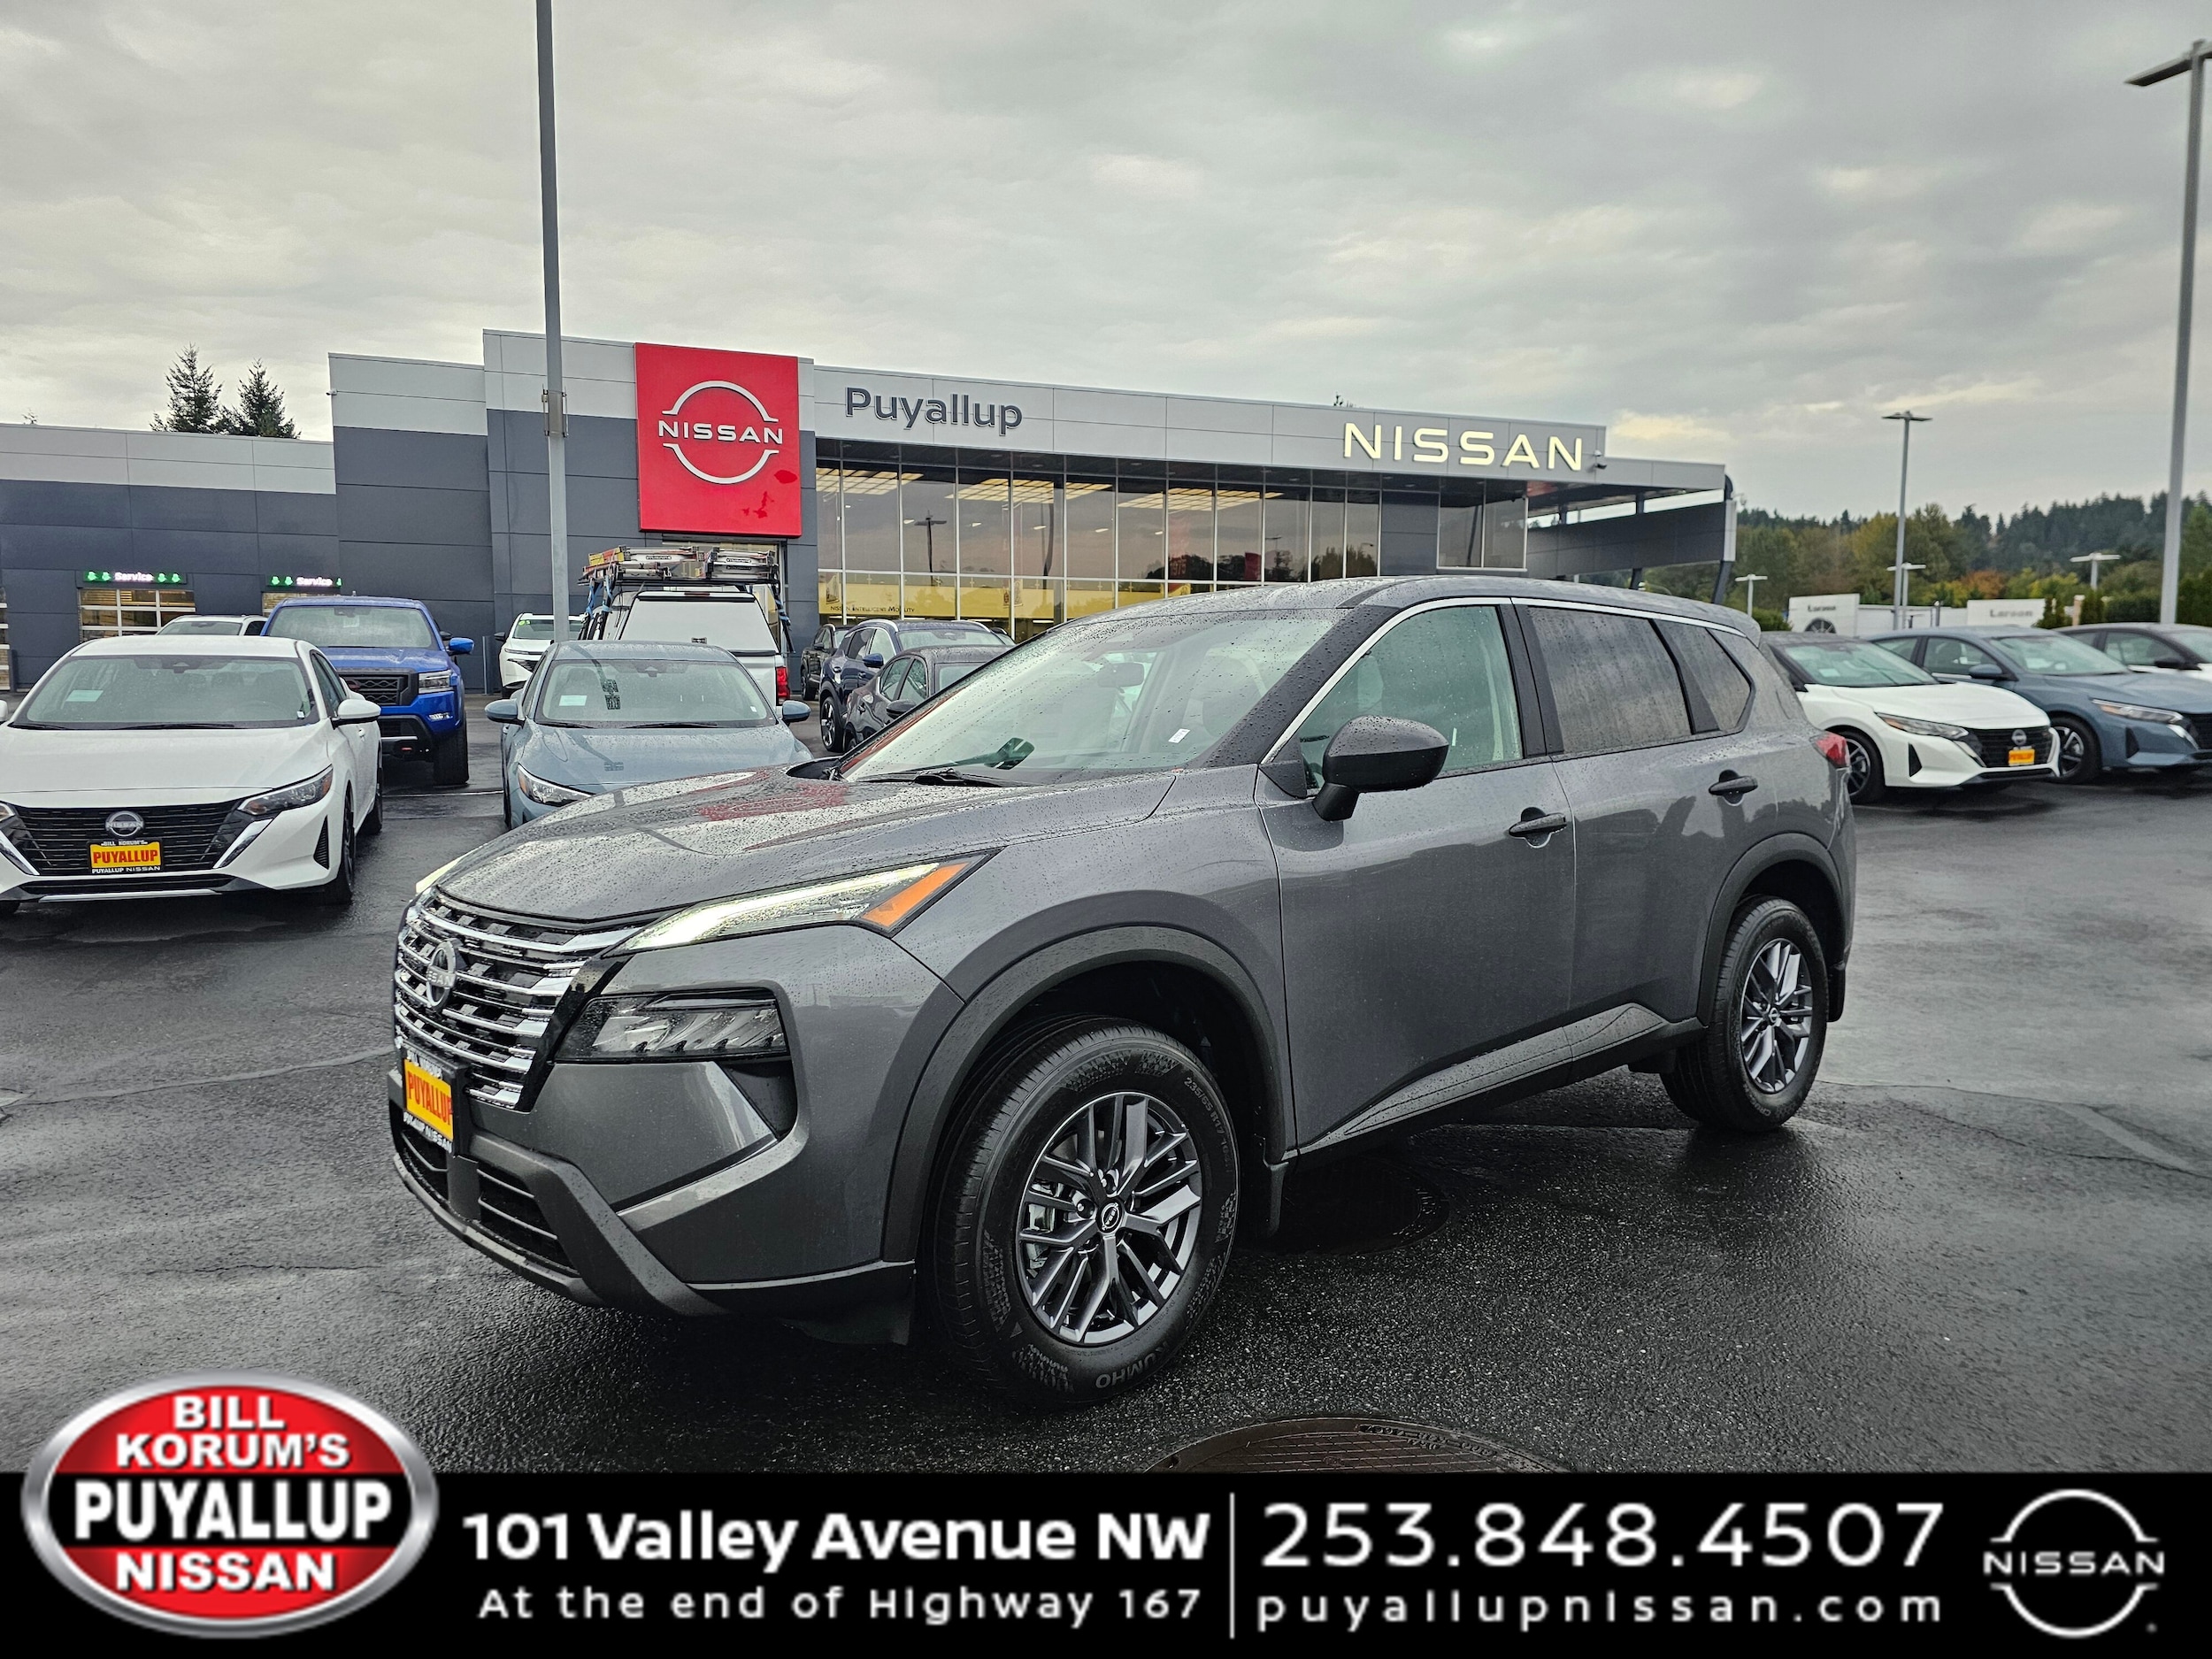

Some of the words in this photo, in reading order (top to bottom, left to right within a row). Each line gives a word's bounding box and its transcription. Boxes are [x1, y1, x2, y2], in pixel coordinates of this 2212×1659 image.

[846, 387, 1023, 436] Puyallup
[657, 419, 784, 445] NISSAN
[1344, 422, 1583, 472] NISSAN
[114, 572, 154, 581] Service
[296, 576, 333, 587] Service
[93, 849, 157, 864] PUYALLUP
